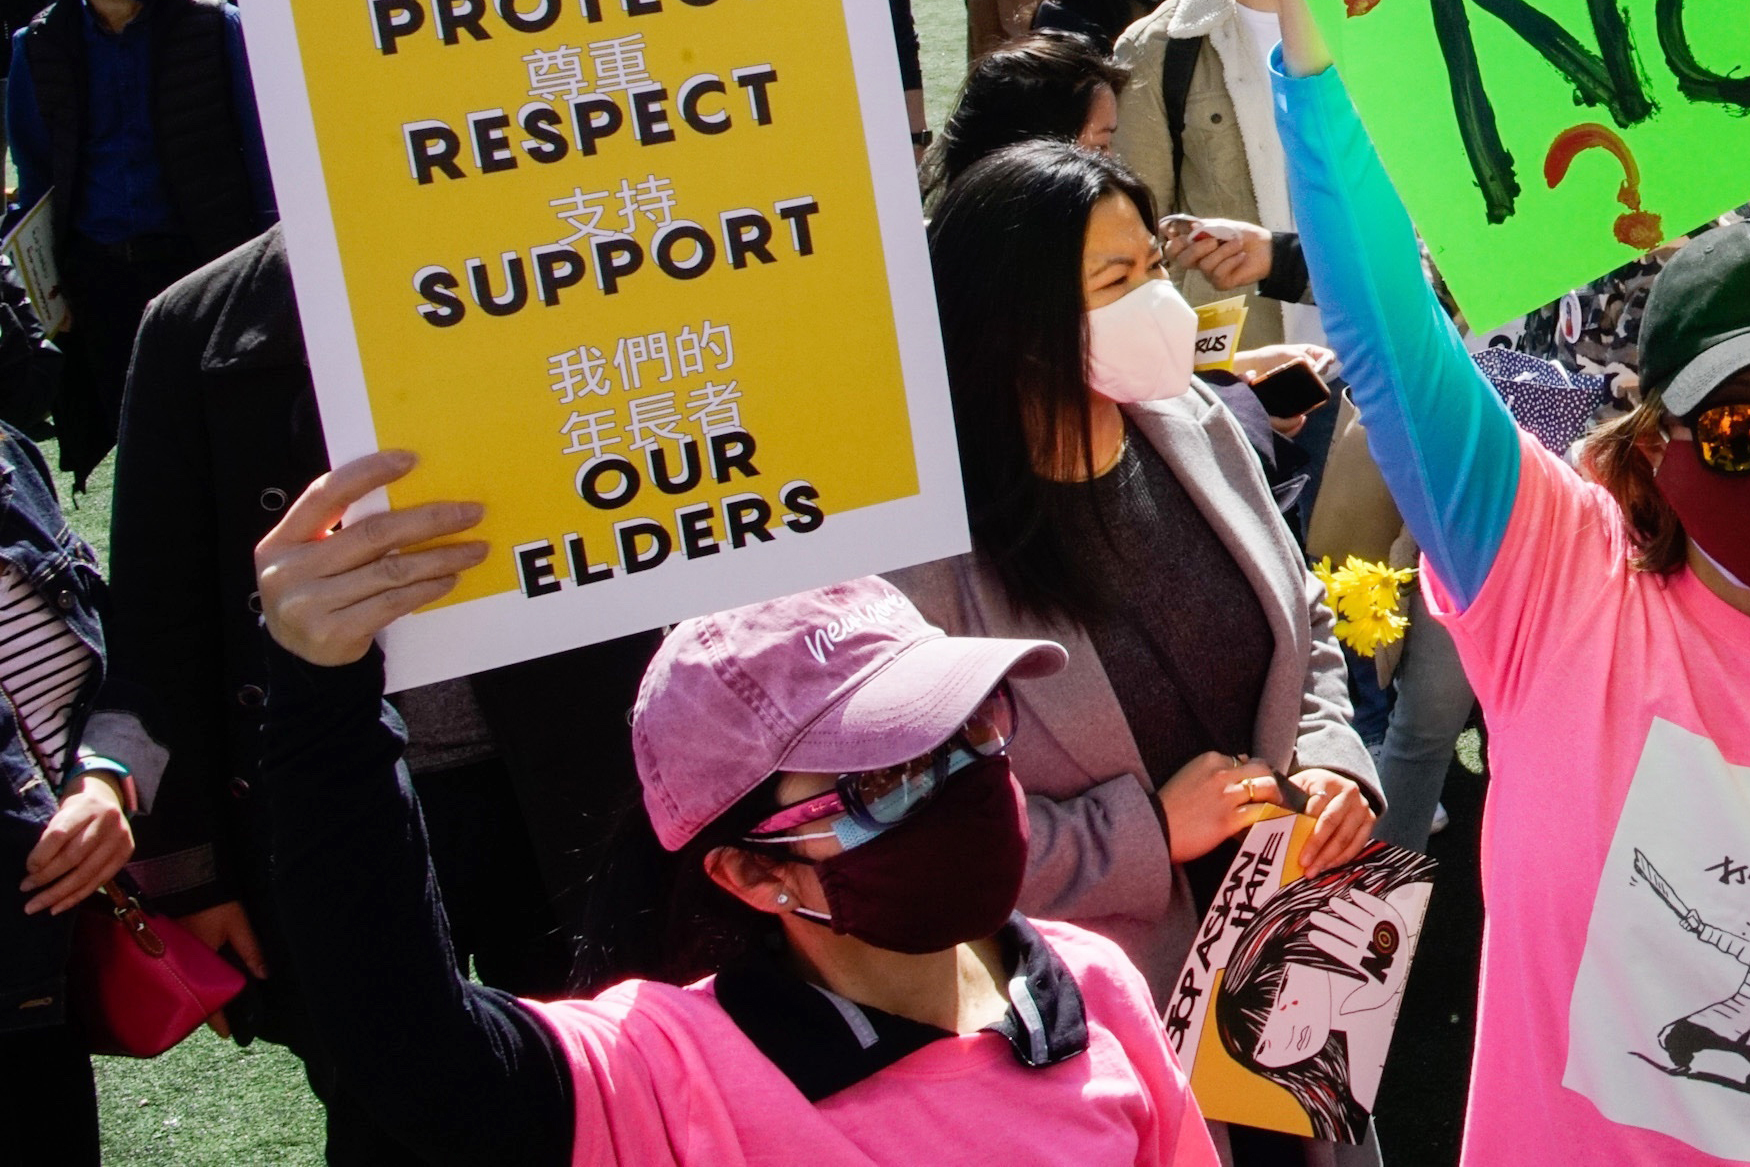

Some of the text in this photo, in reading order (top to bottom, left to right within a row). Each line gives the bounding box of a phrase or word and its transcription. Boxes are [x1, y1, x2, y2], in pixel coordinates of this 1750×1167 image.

[521, 32, 655, 102] 尊重
[401, 63, 778, 186] RESPECT
[549, 174, 678, 246] 支持
[412, 195, 820, 329] SUPPORT
[547, 320, 736, 405] 我們的
[559, 379, 744, 459] 年長者
[574, 425, 761, 511] OUR
[512, 478, 825, 599] ELDERS
[1230, 831, 1285, 929] HATE
